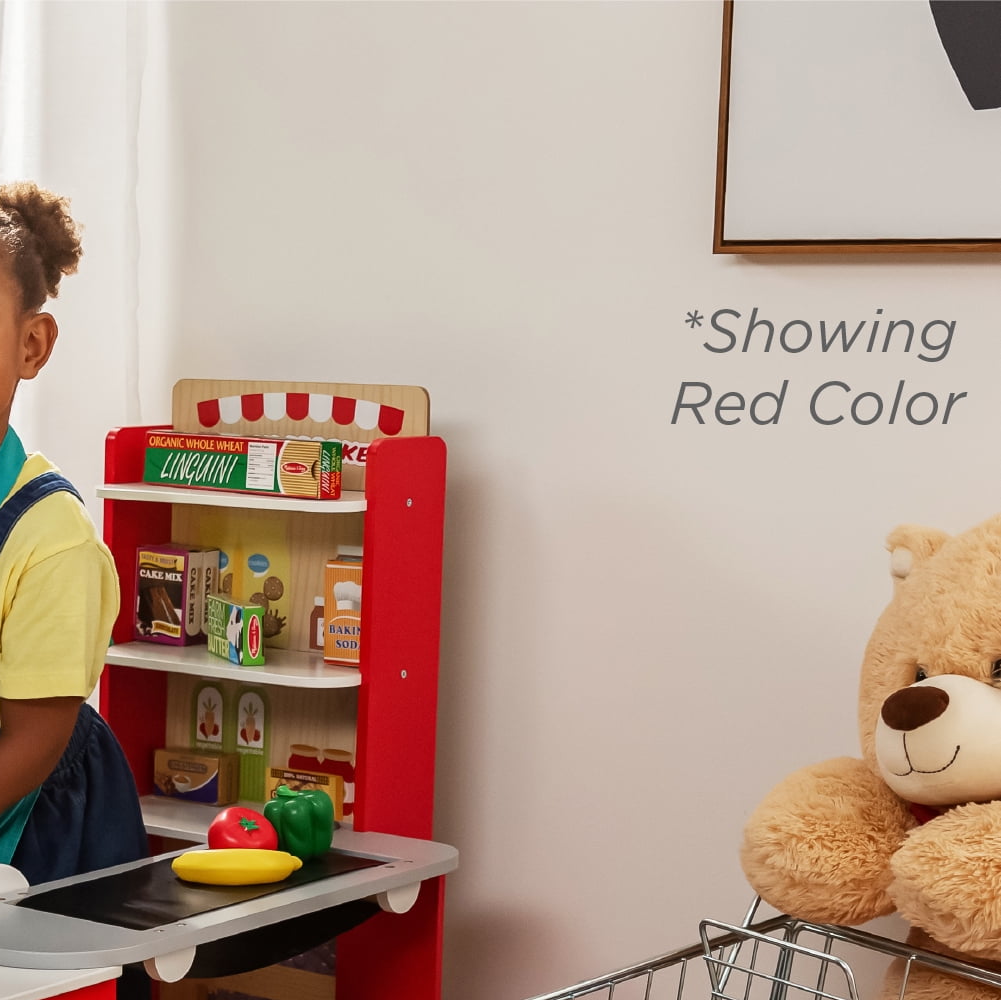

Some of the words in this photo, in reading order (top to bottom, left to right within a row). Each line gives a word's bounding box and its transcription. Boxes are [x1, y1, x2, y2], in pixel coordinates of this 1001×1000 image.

[149, 436, 185, 448] ORGANIC
[186, 438, 215, 450] WHOLE
[216, 440, 245, 452] WHEAT
[160, 452, 239, 486] LINGUINI
[140, 568, 164, 580] CAKE
[165, 572, 183, 582] MIX
[336, 640, 361, 650] SOD
